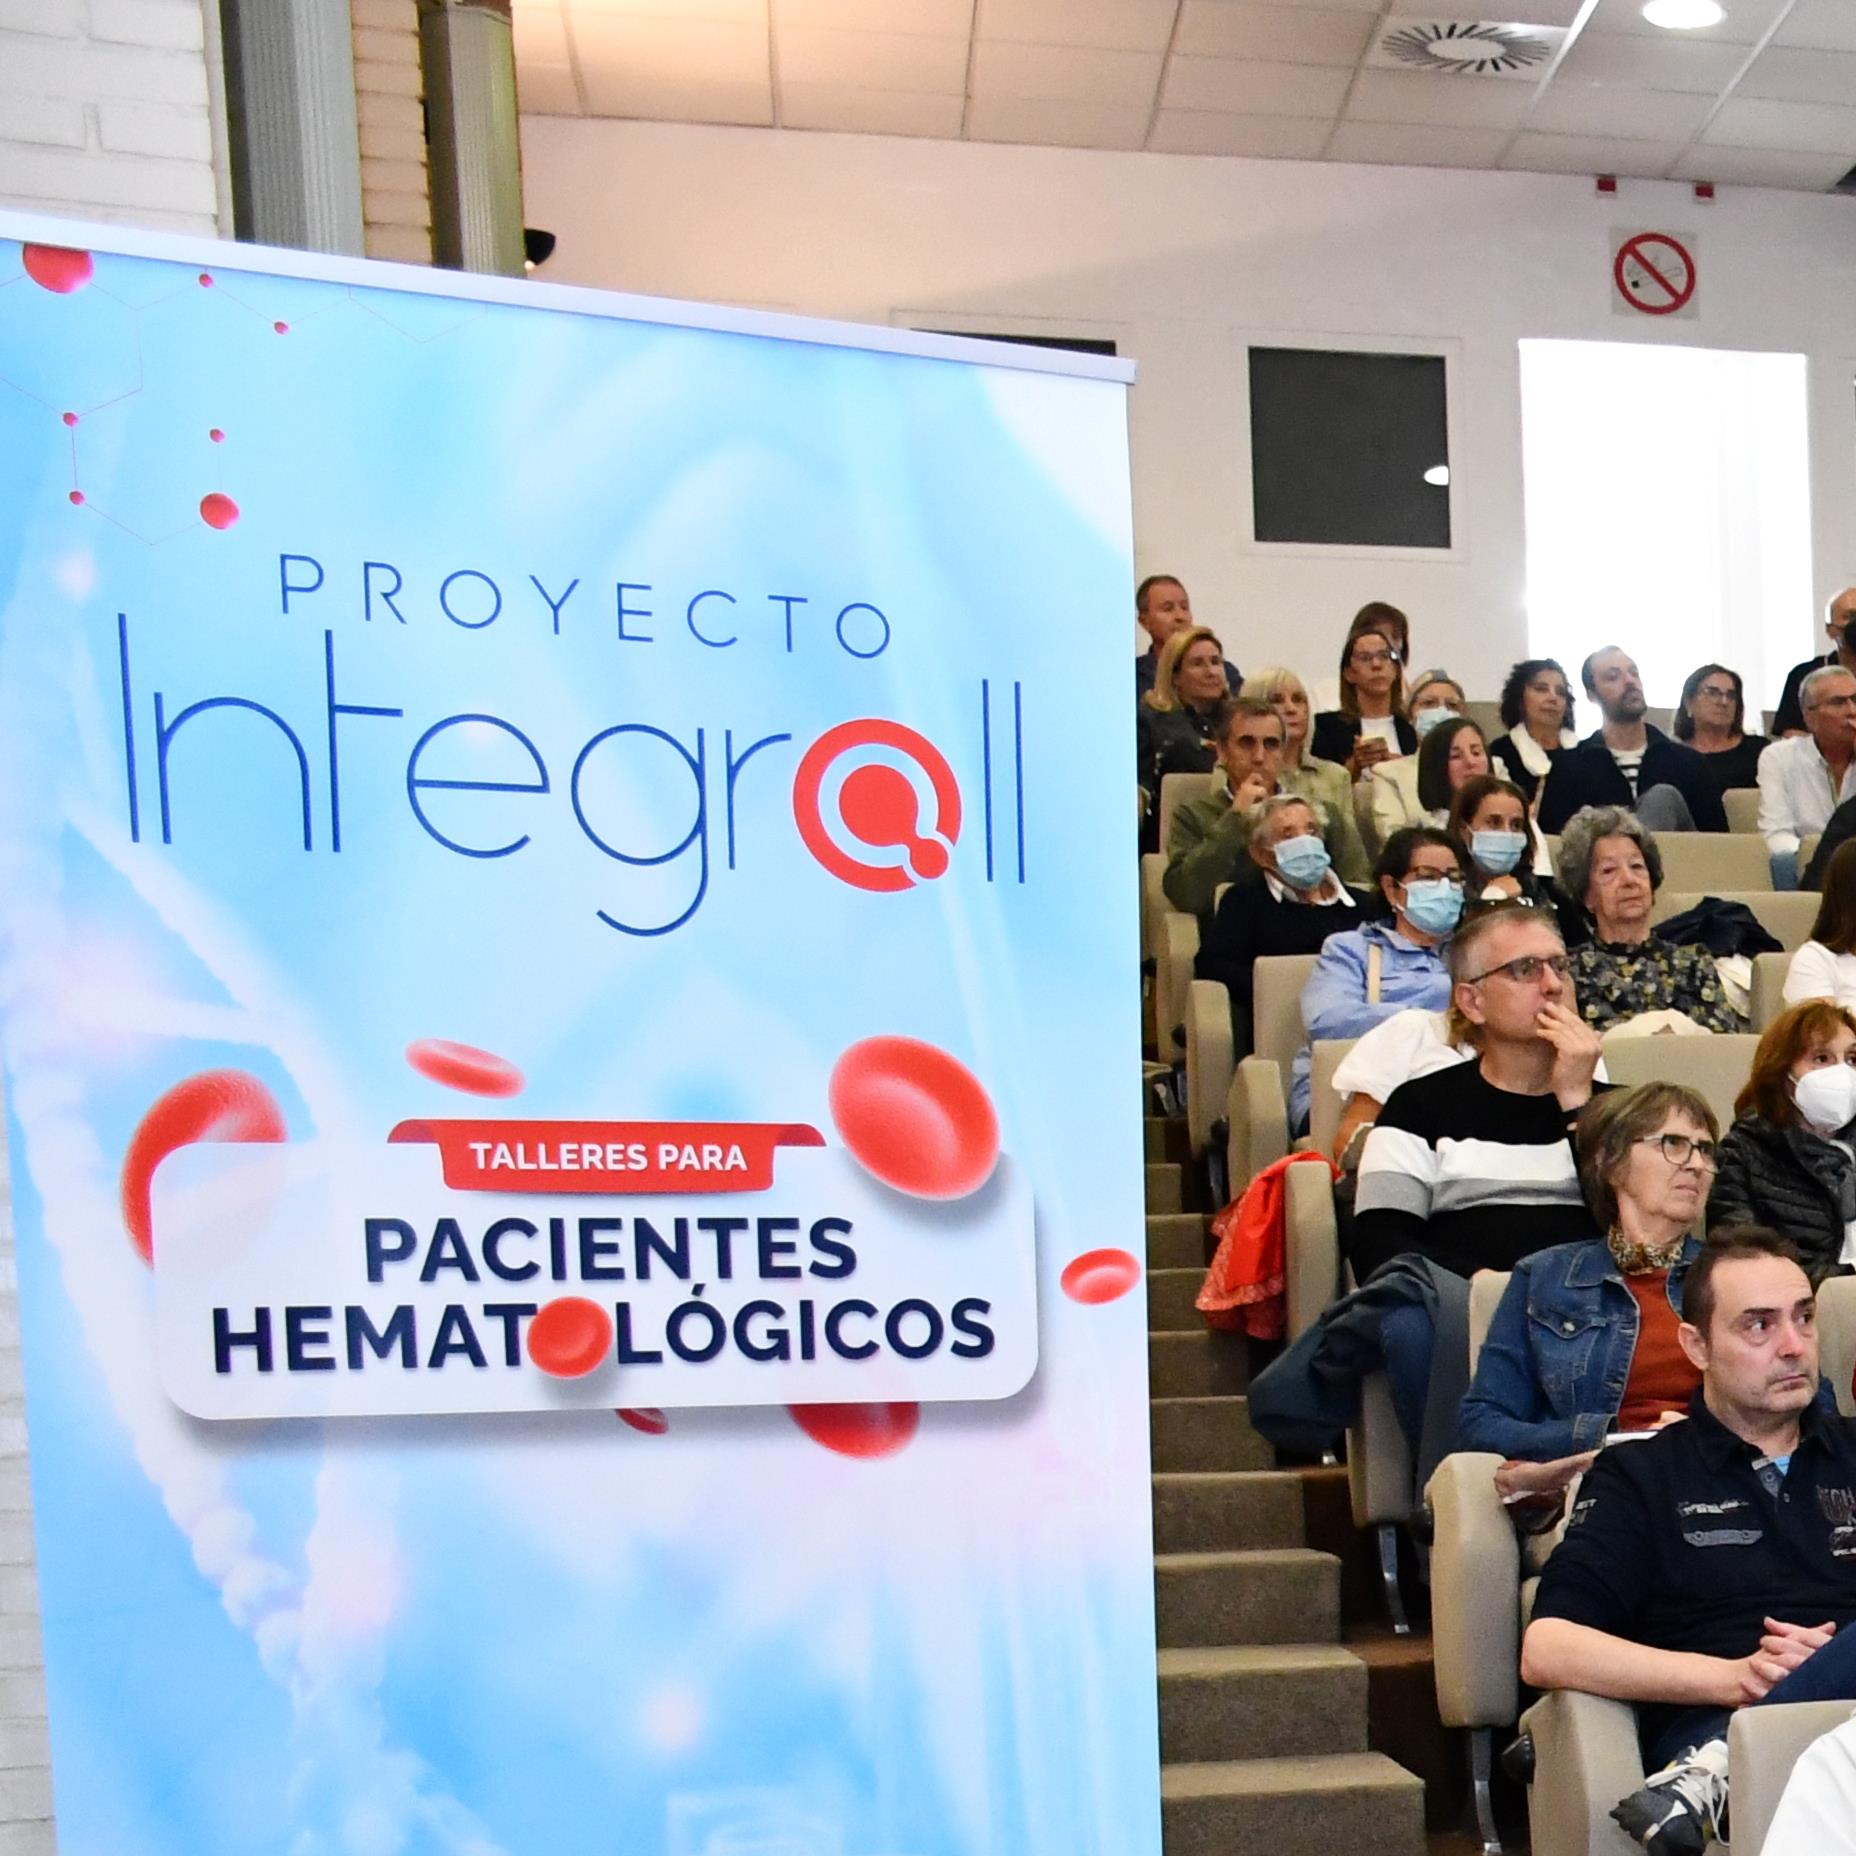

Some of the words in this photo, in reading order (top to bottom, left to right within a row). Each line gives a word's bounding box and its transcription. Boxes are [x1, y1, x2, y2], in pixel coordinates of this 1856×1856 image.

[279, 553, 891, 659] PROYECTO
[469, 1142, 648, 1172] TALLERES
[658, 1144, 748, 1173] PARA
[364, 1217, 858, 1283] PACIENTES
